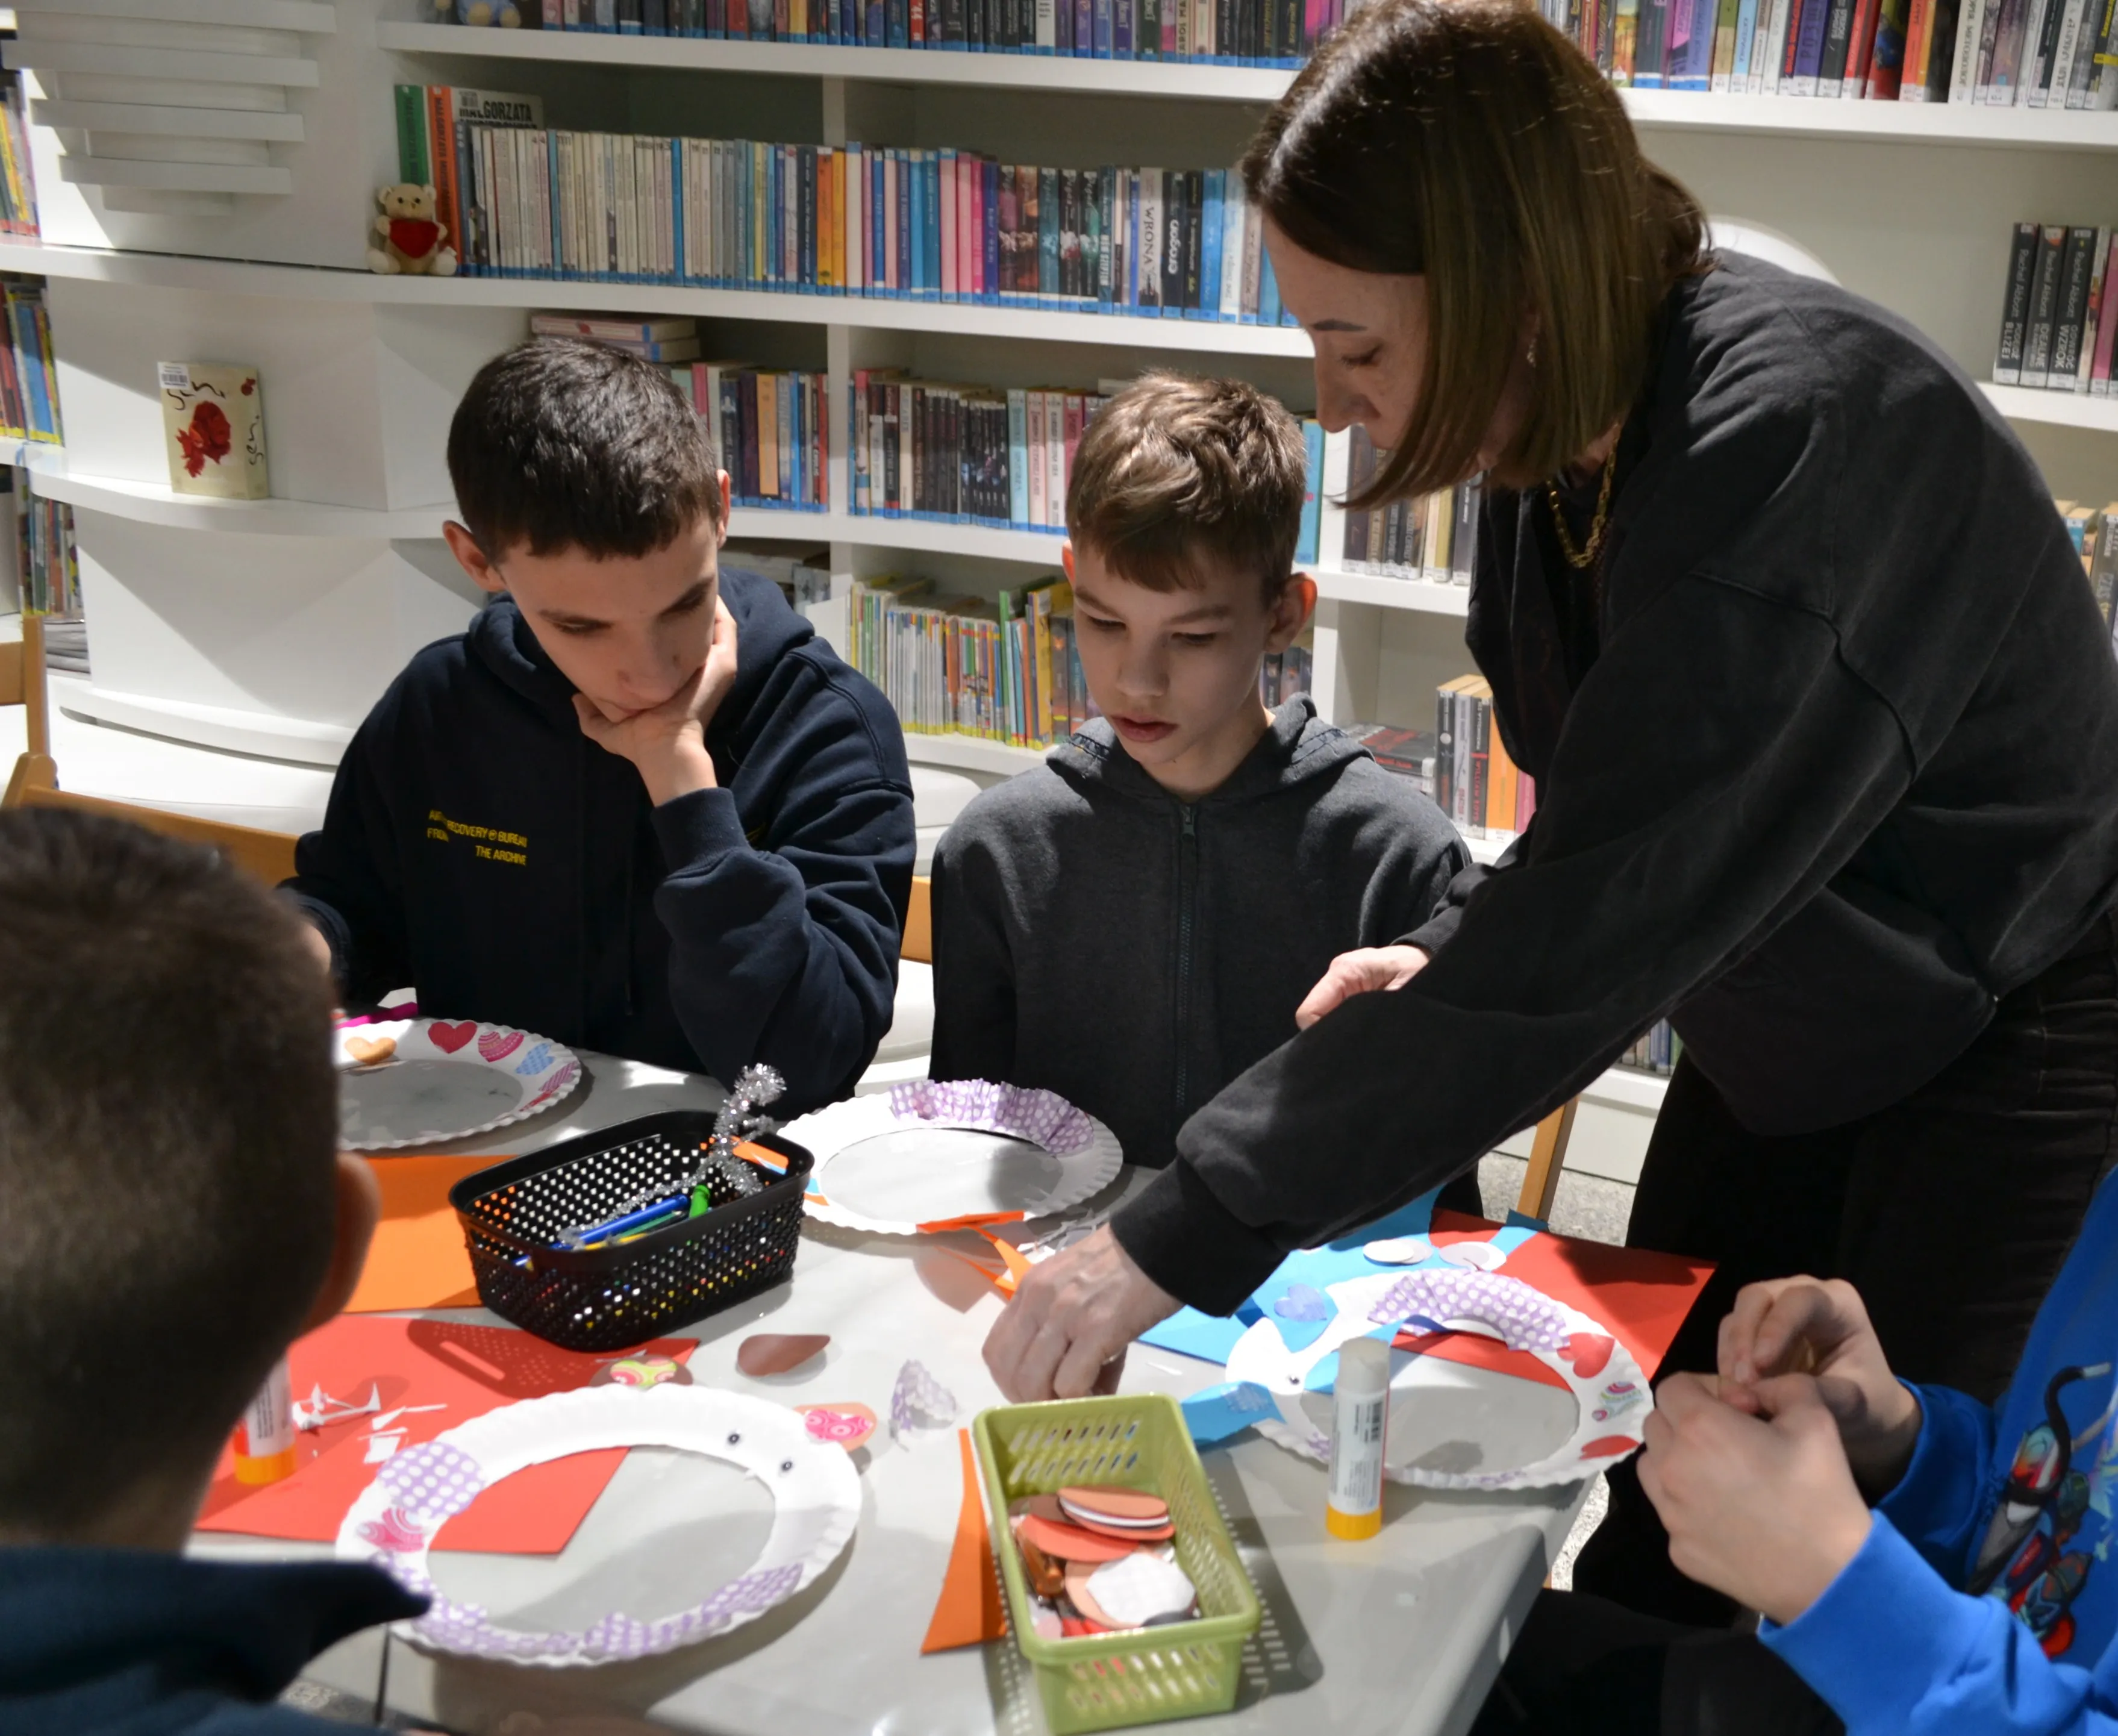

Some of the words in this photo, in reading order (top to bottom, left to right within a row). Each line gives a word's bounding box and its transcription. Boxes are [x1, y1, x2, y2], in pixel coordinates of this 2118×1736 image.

[1142, 207, 1155, 266] WRONA
[2016, 248, 2029, 282] Rachel
[2043, 251, 2057, 283] Rachel
[2070, 251, 2085, 283] Rachel
[2011, 283, 2024, 317] Abbott
[2038, 284, 2051, 318] Abbott
[2066, 285, 2079, 319] Abbott
[2054, 323, 2069, 369] WZROK
[475, 845, 492, 859] THE
